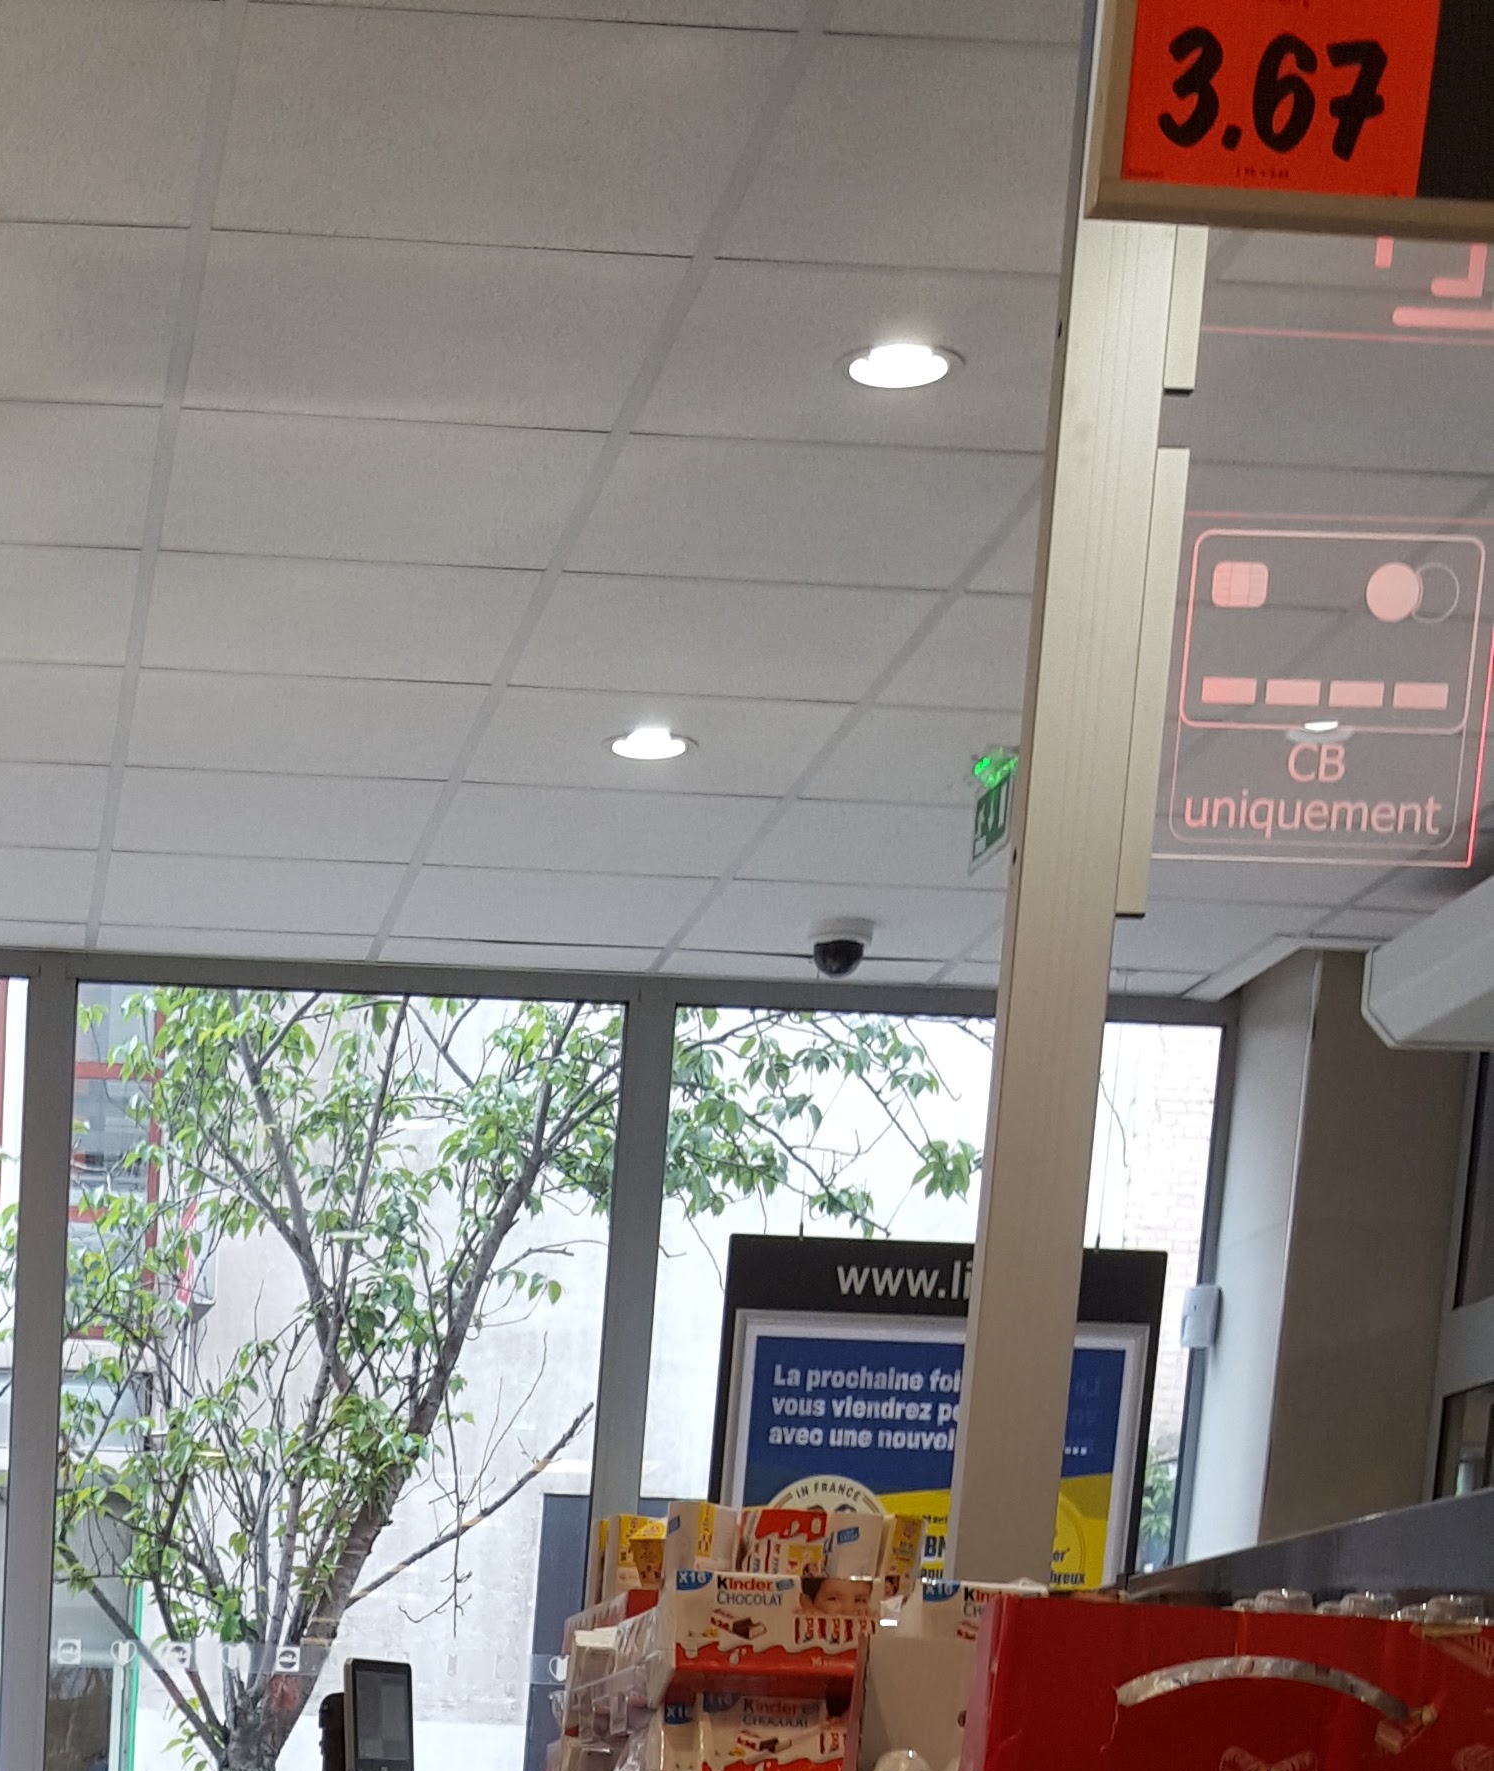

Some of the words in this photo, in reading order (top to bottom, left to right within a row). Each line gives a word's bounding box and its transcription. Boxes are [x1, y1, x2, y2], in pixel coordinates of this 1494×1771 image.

[1158, 27, 1389, 160] 3.67
[1286, 743, 1347, 785] CB
[1184, 793, 1442, 838] uniquement
[836, 1259, 973, 1301] www.li
[774, 1364, 801, 1387] La
[806, 1366, 924, 1392] prochaine
[929, 1368, 962, 1392] foi
[772, 1397, 826, 1418] vous
[831, 1396, 932, 1421] viendrez
[768, 1425, 824, 1446] avec
[829, 1429, 872, 1449] une
[878, 1429, 956, 1451] nouvel
[795, 1484, 809, 1500] IN
[813, 1481, 861, 1501] FRANCE
